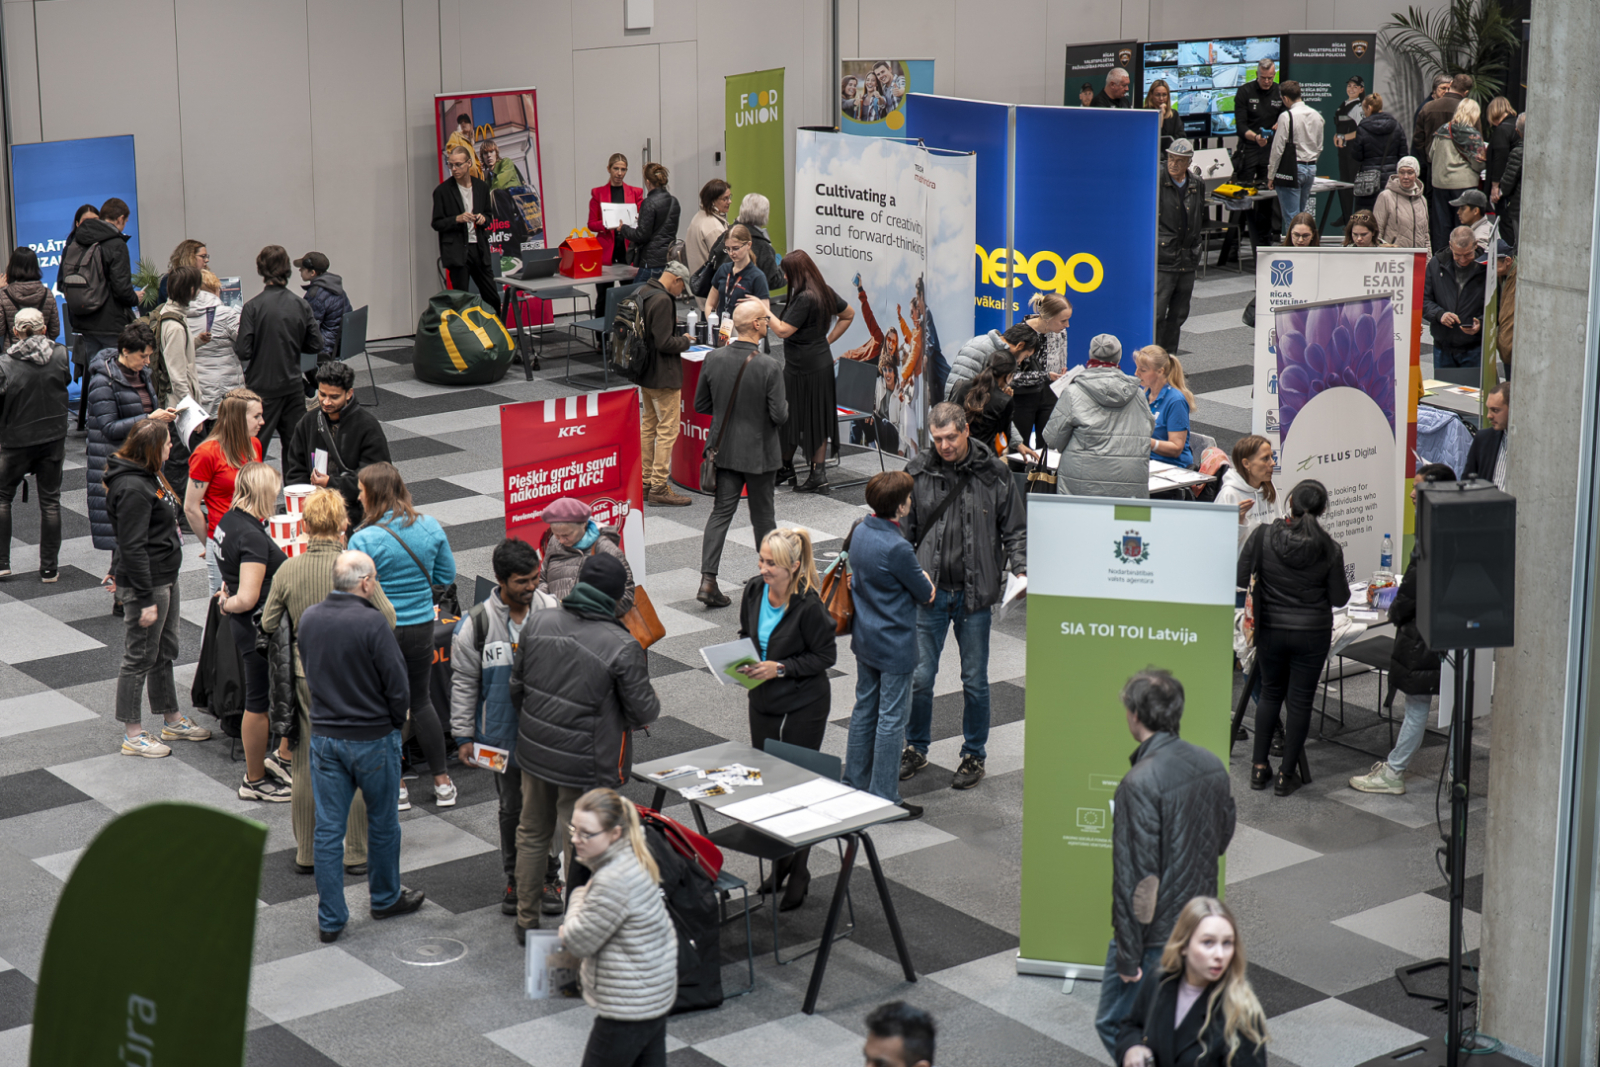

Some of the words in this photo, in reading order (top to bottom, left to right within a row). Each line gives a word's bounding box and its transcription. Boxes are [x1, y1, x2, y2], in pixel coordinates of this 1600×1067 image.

[740, 89, 778, 110] FOOD
[735, 105, 778, 128] UNION
[815, 183, 887, 208] Cultivating
[889, 195, 897, 207] a
[815, 203, 865, 221] culture
[870, 210, 883, 223] of
[815, 223, 841, 237] and
[848, 225, 925, 261] forward-thinking
[815, 242, 873, 262] solutions
[1374, 259, 1406, 274] MĒS
[1363, 275, 1405, 287] ESAM
[1269, 290, 1292, 298] RĪGAS
[557, 425, 586, 438] KFC
[1316, 450, 1351, 465] TELUS
[1354, 445, 1377, 459] Digital
[550, 461, 584, 483] garšu
[586, 451, 617, 472] savai
[510, 479, 561, 504] nākotnei
[563, 478, 577, 492] ar
[578, 469, 604, 488] KFC!
[1333, 485, 1357, 494] looking
[1358, 483, 1368, 491] for
[593, 502, 609, 512] KFC
[1330, 494, 1363, 507] ndividuals
[1363, 492, 1377, 501] who
[611, 502, 629, 517] Big
[1321, 508, 1345, 520] English
[1345, 505, 1364, 514] along
[1364, 502, 1378, 511] with
[1335, 516, 1365, 527] language
[1366, 514, 1374, 522] to
[1333, 530, 1345, 539] top
[1345, 526, 1365, 536] teams
[1060, 621, 1086, 636] SIA
[1088, 623, 1114, 637] TOI
[1118, 625, 1144, 639] TOI
[1148, 627, 1198, 646] Latvija
